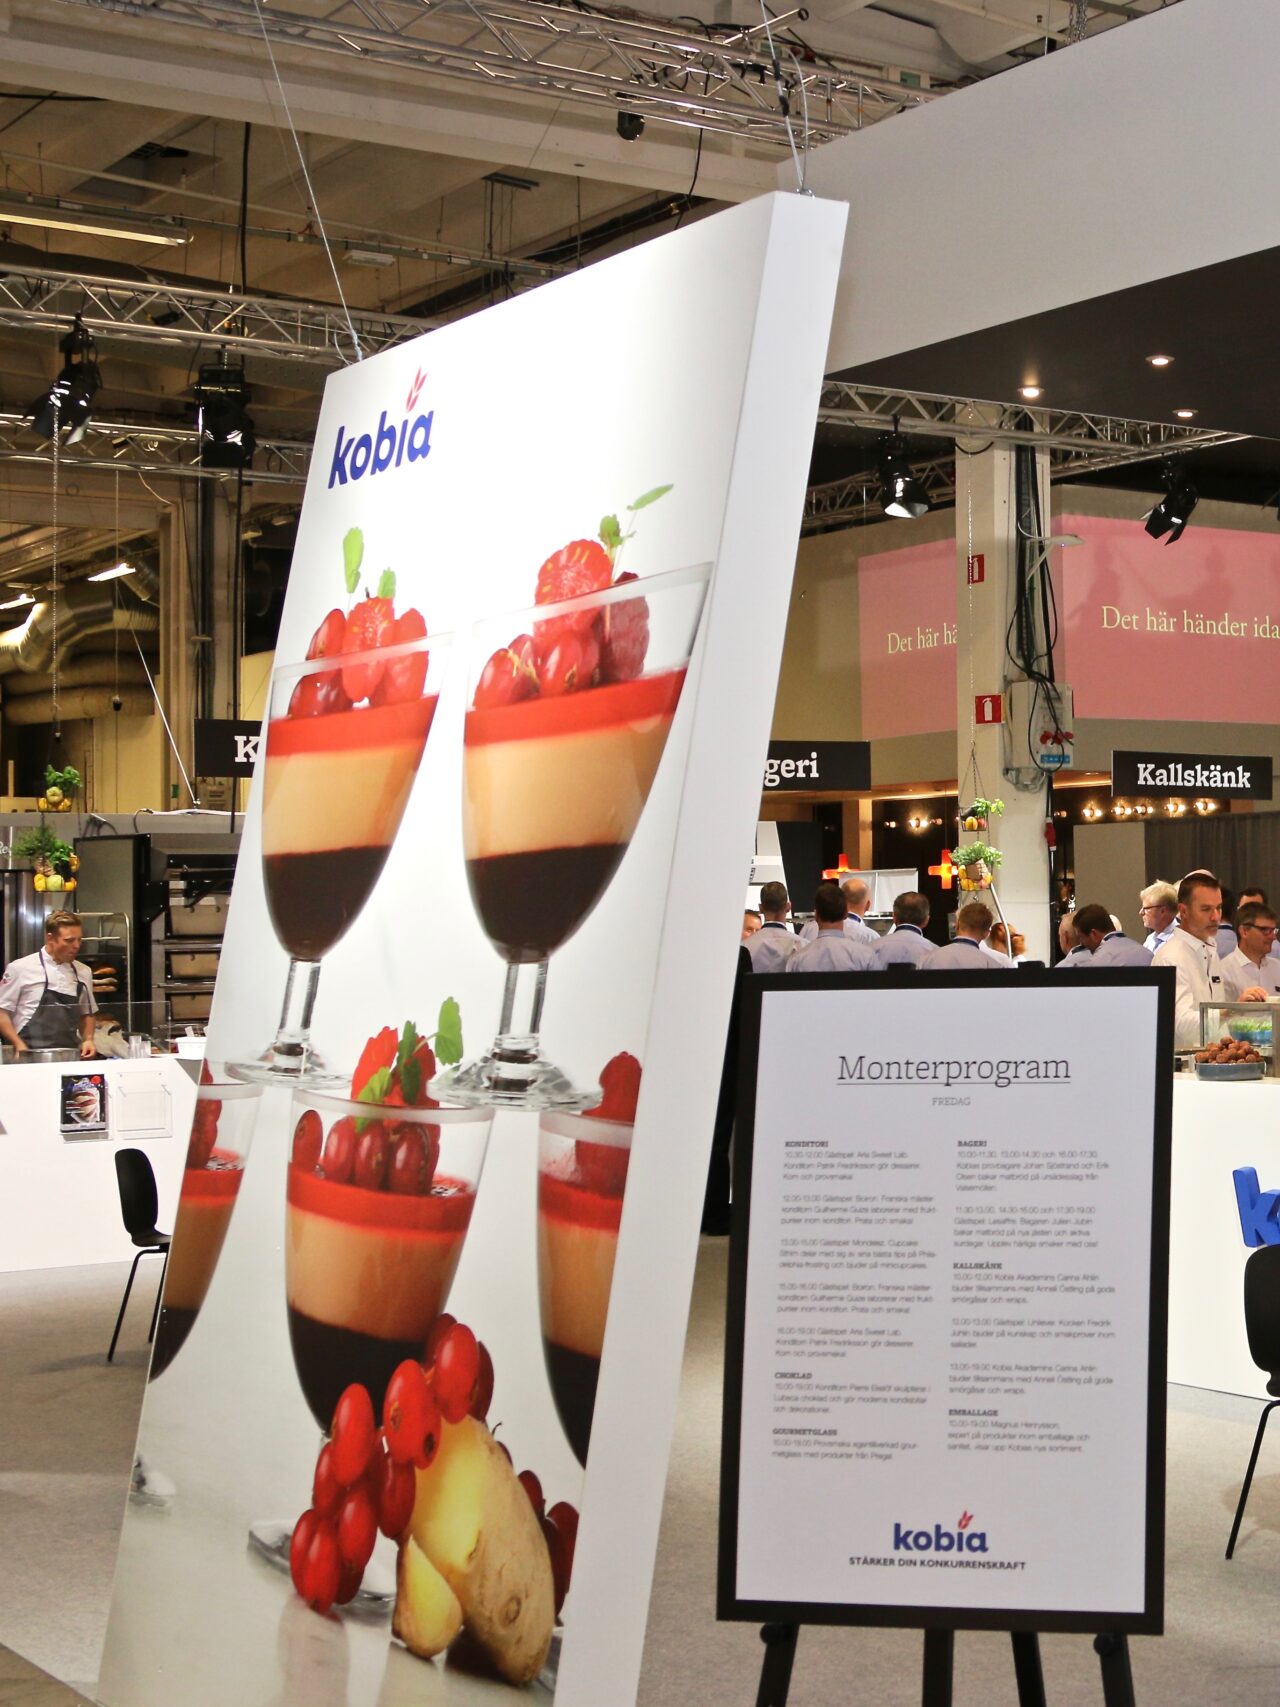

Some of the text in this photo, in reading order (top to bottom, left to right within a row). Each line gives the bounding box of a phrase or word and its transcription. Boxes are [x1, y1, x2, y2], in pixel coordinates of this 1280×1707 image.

[328, 406, 434, 490] kobia
[1101, 605, 1139, 631] Det
[1146, 607, 1177, 632] här
[1183, 610, 1248, 636] händer
[887, 632, 913, 654] Det
[917, 626, 939, 649] här
[1137, 762, 1251, 789] Kallskänk
[837, 1055, 1072, 1088] Monterprogram
[893, 1520, 989, 1552] kobia
[849, 1556, 1026, 1570] STÄRKER DIN KONKURRENSKRAFT
